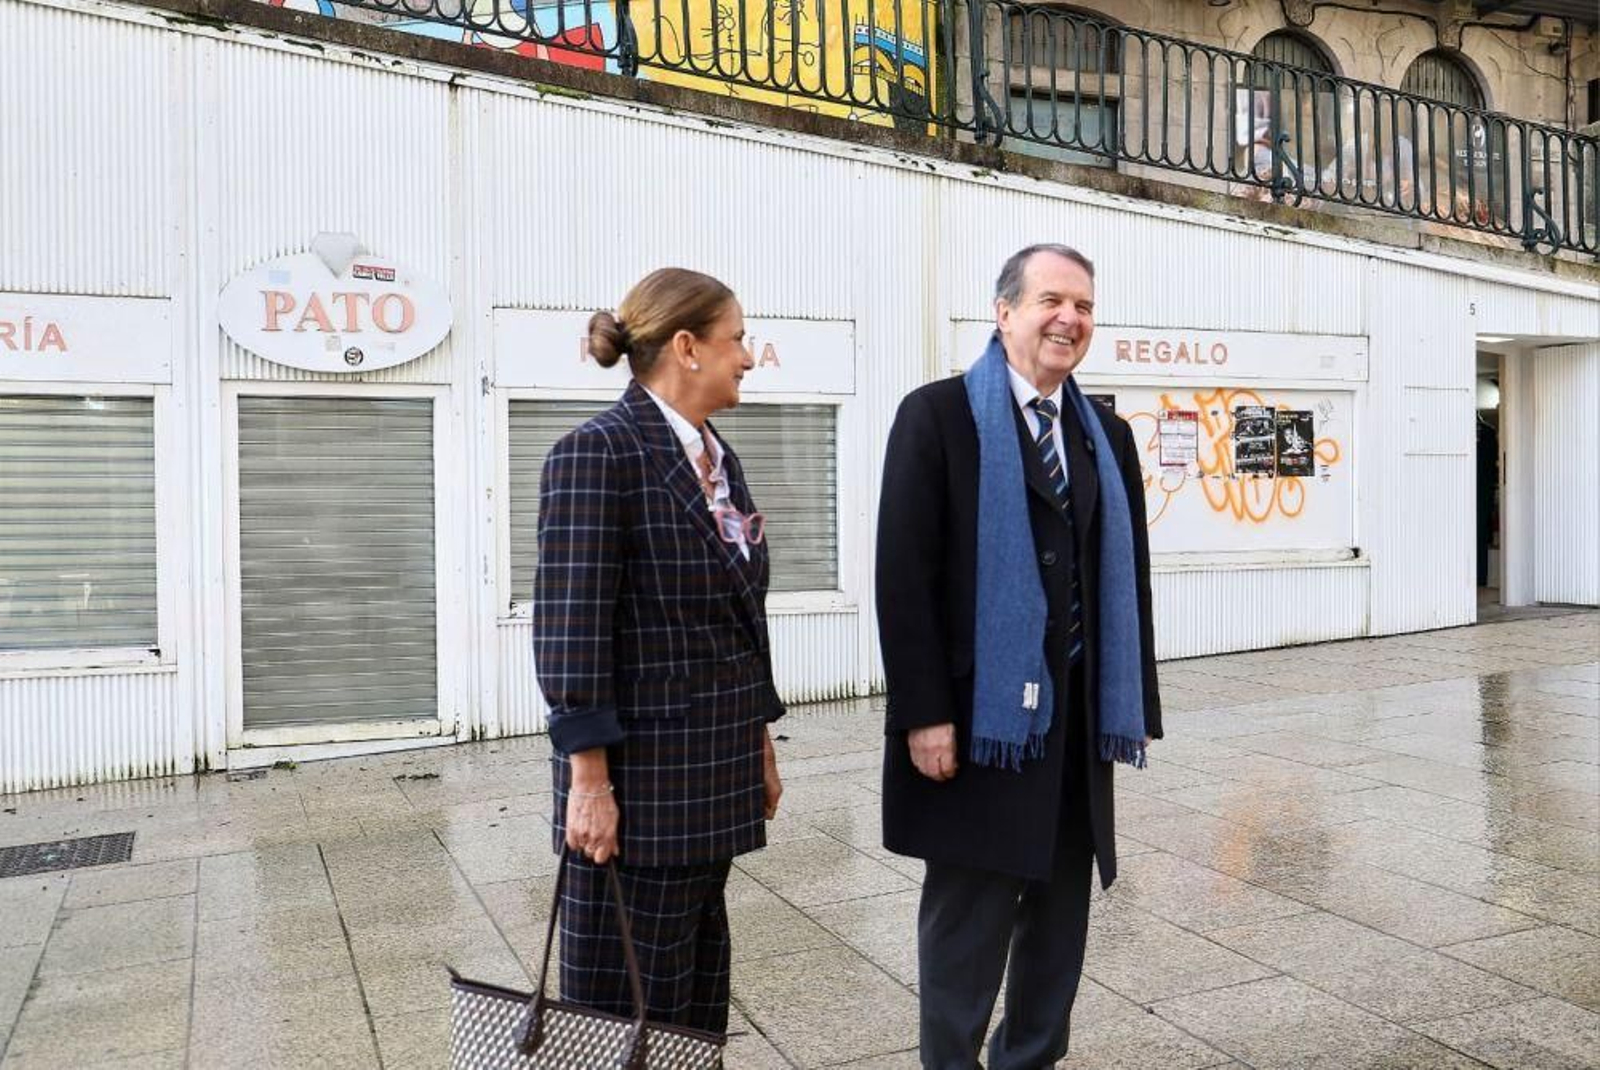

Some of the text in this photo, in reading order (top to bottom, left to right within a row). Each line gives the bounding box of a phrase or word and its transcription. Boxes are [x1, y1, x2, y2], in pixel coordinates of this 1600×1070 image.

[259, 290, 415, 334] PATO
[1469, 302, 1476, 316] 5
[1115, 339, 1228, 365] REGALO
